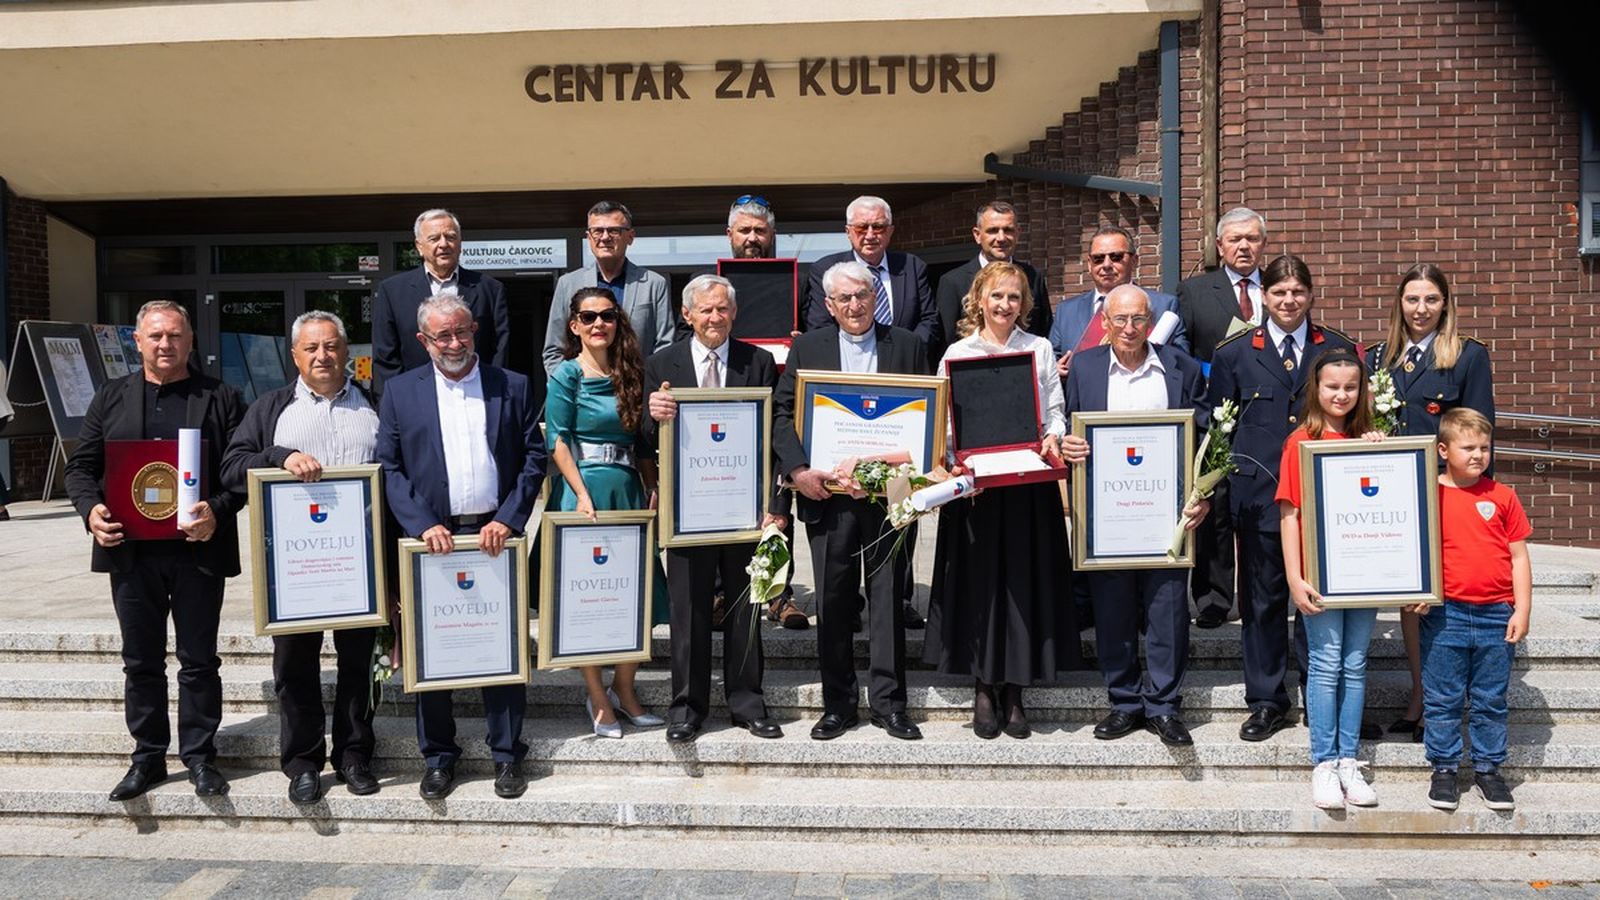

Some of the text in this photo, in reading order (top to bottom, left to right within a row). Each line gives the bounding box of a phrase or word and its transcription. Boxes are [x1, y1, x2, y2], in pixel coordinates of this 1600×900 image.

[524, 53, 996, 103] CENTAR ZA KULTURU
[462, 245, 553, 257] KULTURU ČAKOVEC
[689, 455, 748, 470] POVELJU
[1103, 479, 1167, 494] POVELJU
[1335, 510, 1408, 526] POVELJU
[285, 536, 355, 553] POVELJU
[570, 577, 630, 592] POVELJU
[433, 601, 500, 618] POVELJU
